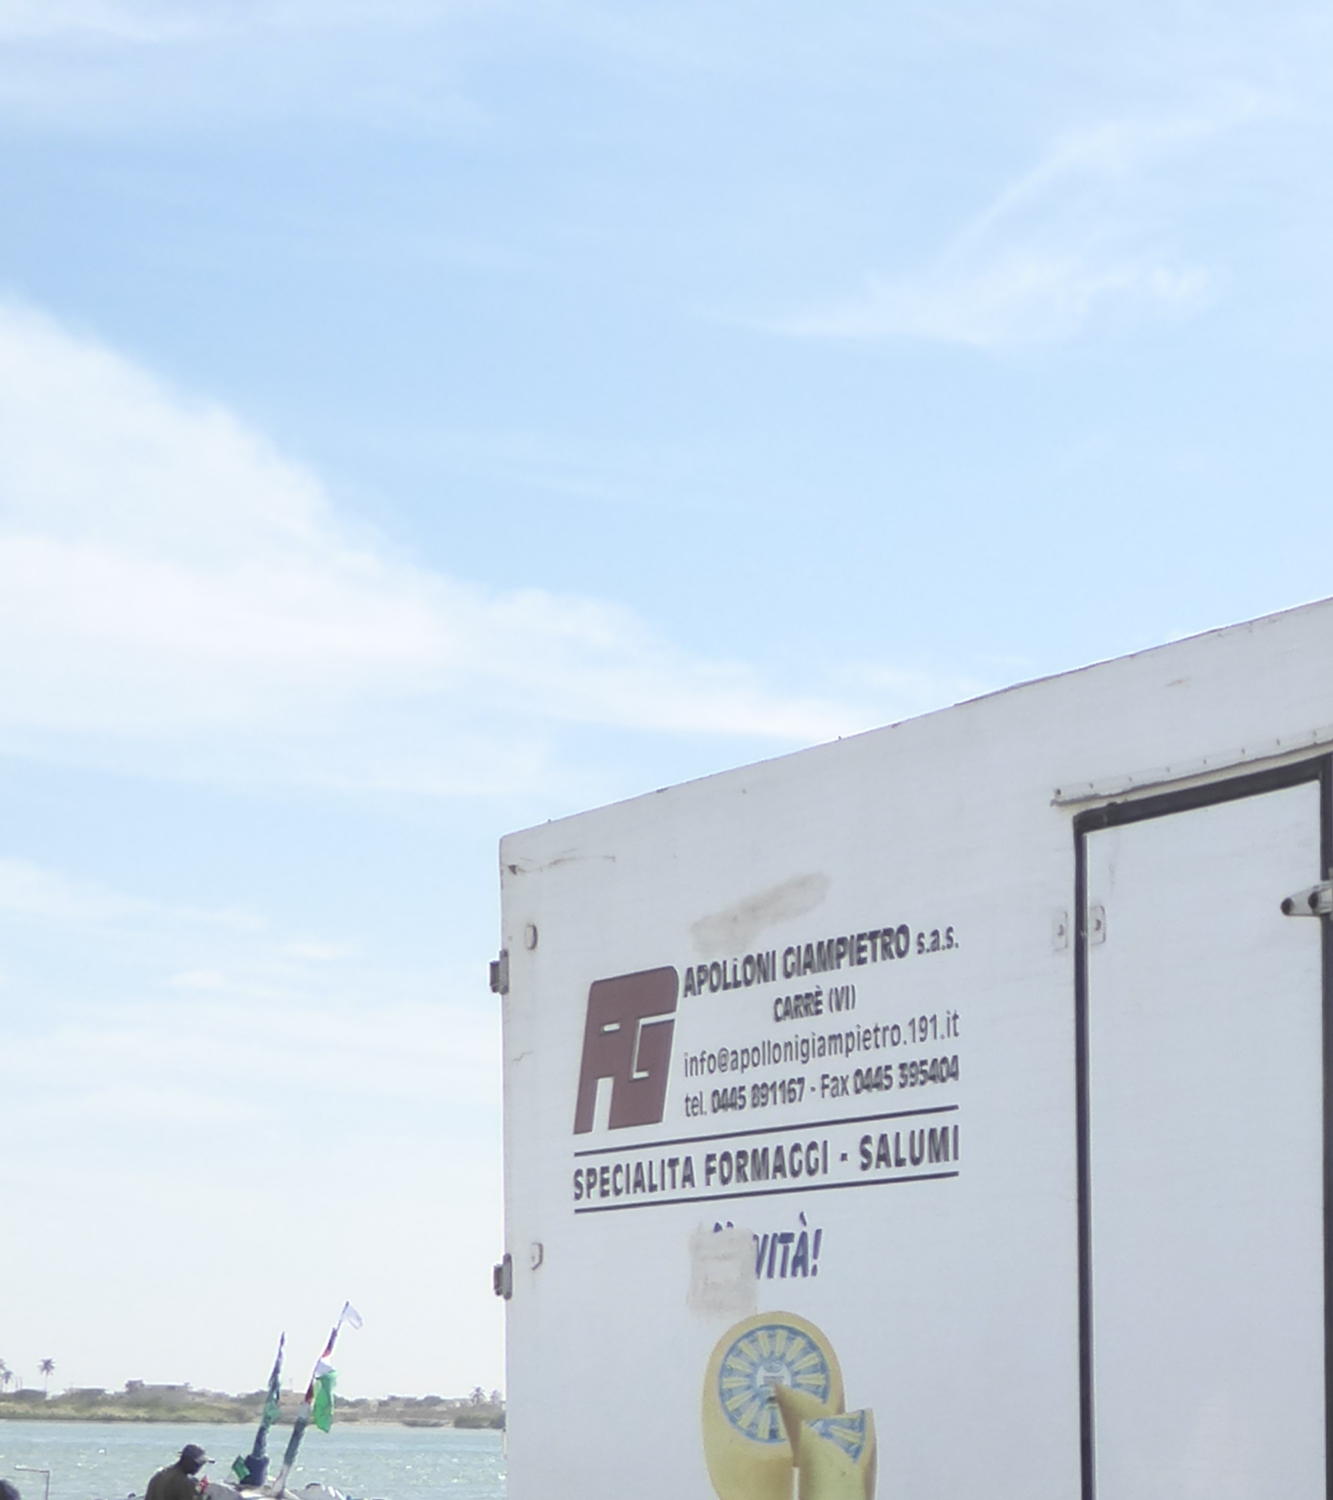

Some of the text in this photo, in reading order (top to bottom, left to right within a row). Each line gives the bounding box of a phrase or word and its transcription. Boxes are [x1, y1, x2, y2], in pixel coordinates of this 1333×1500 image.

[683, 923, 960, 998] APOLLONI GIAMPIETRO s.a.s.
[773, 984, 857, 1023] CARRÈ (VI)
[683, 1010, 960, 1078] info@apollonigiampietro.191.it
[684, 1091, 708, 1118] tel.
[820, 1072, 850, 1100] Fax
[573, 1156, 696, 1201] SPECIALITA
[704, 1140, 829, 1187] FORMAGGI
[859, 1125, 960, 1171] SALUMI
